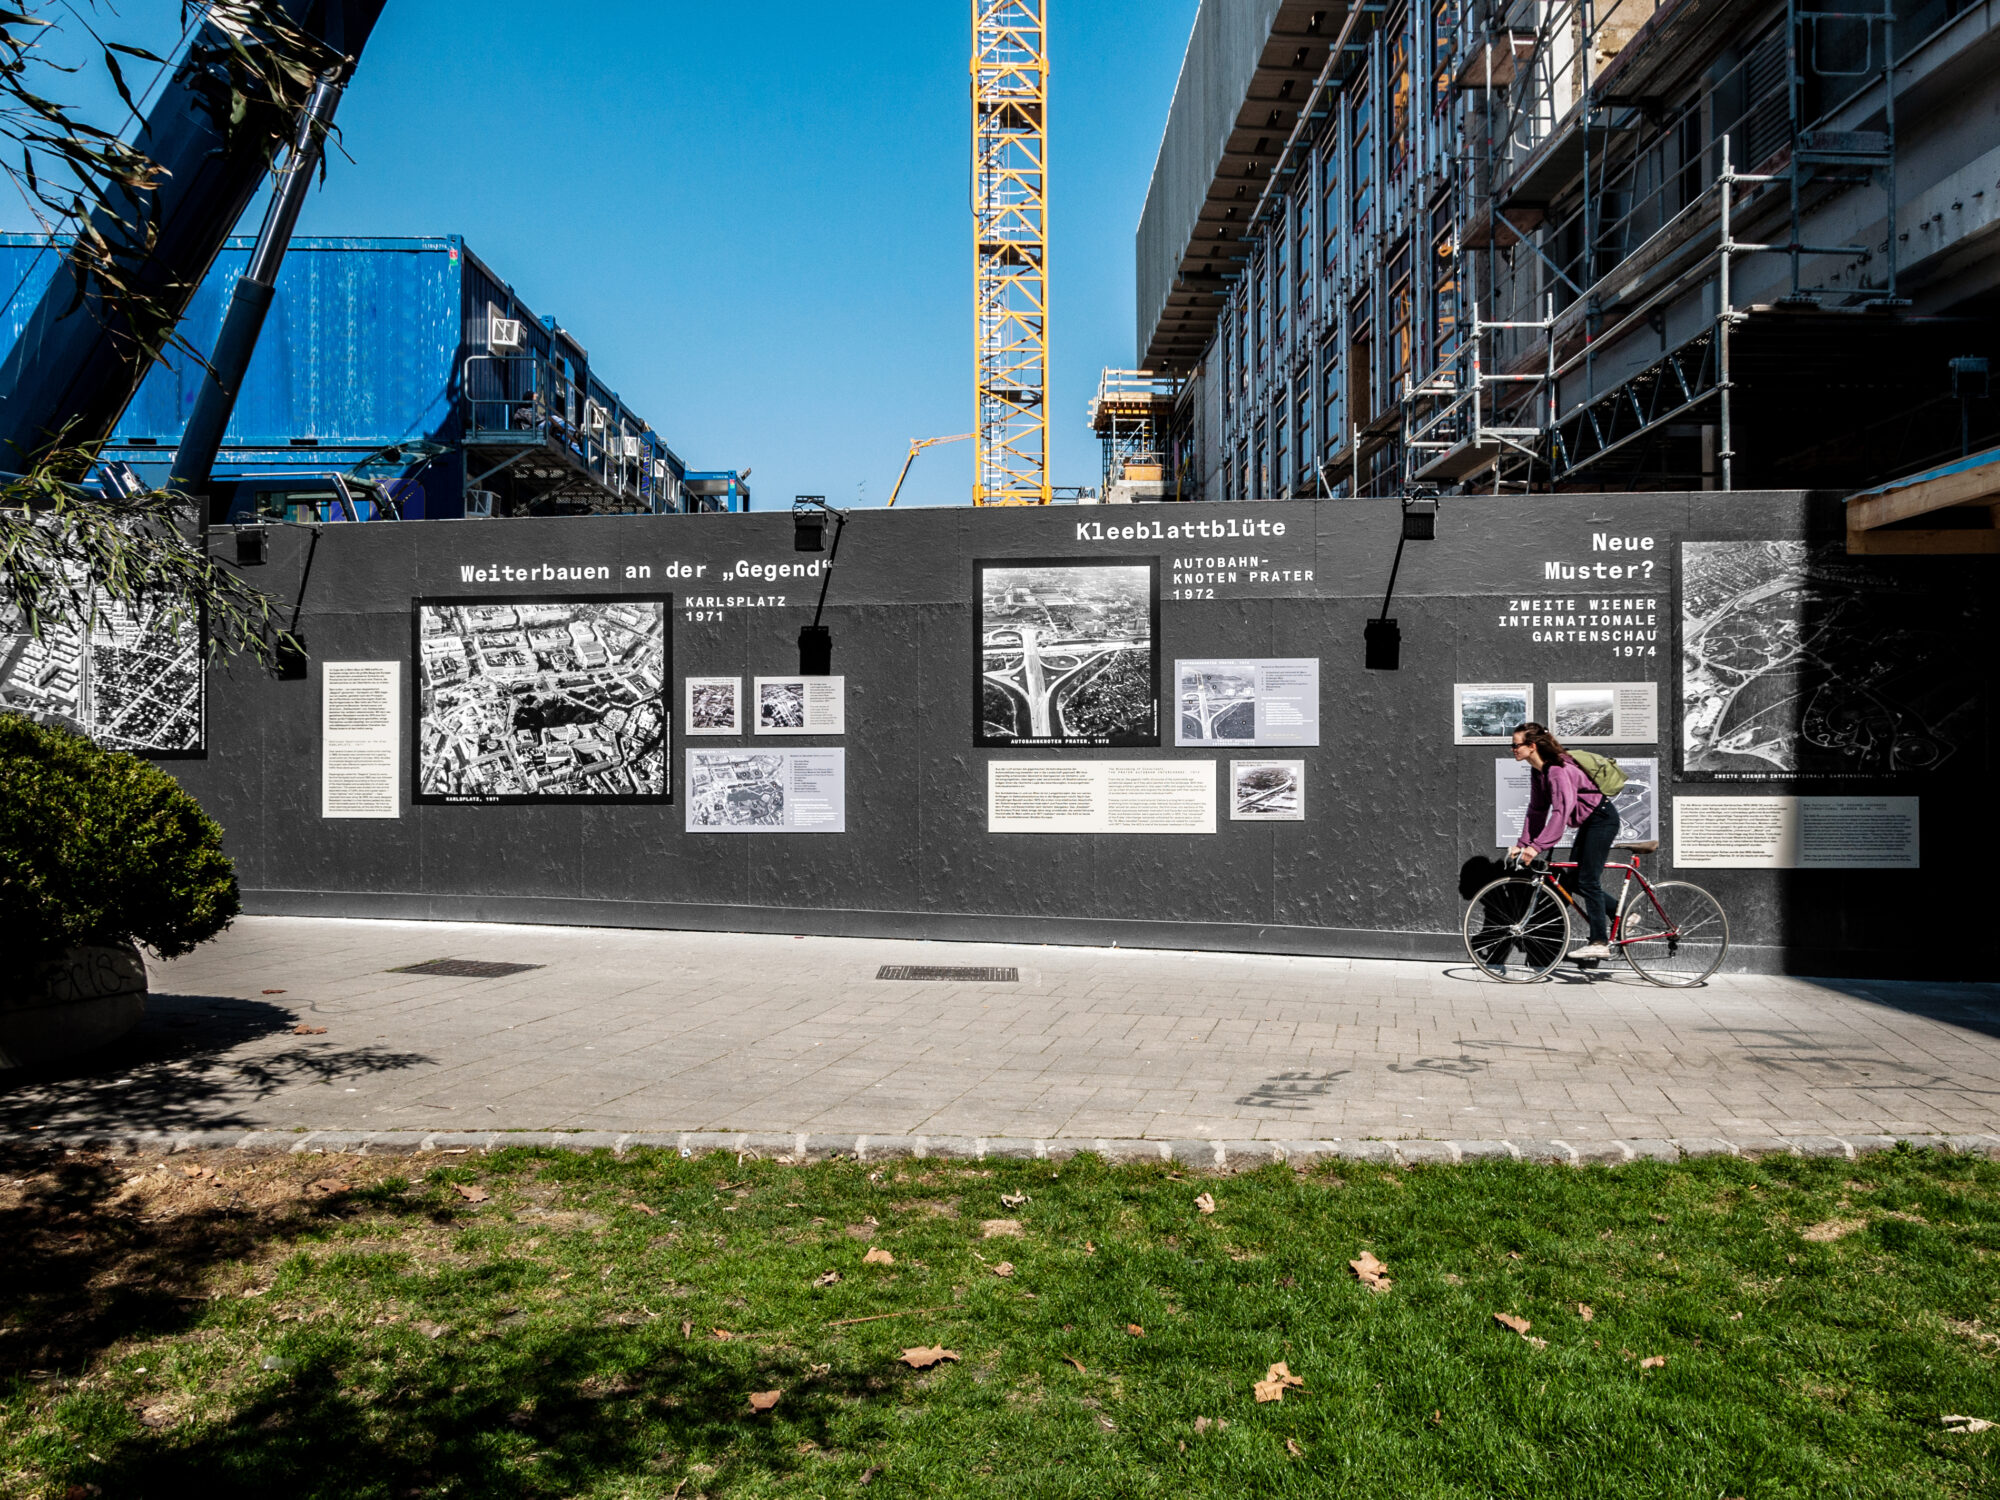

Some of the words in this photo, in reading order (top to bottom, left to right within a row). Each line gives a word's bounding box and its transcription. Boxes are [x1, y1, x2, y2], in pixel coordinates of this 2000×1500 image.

[1076, 518, 1286, 541] Kleeblattblüte
[1592, 532, 1655, 552] Neue
[1172, 555, 1269, 570] AUTOBAHN-
[1544, 559, 1654, 580] Muster?
[460, 563, 610, 583] Weiterbauen
[625, 565, 651, 579] an
[665, 560, 707, 579] der
[722, 559, 835, 582] „Gegend“
[1173, 571, 1237, 585] KNOTEN
[1249, 569, 1314, 583] PRATER
[685, 595, 786, 608] KARLSPLATZ
[1172, 588, 1215, 601] 1972
[1509, 599, 1576, 612] ZWEITE
[1588, 598, 1657, 611] WIENER
[685, 610, 723, 622] 1971
[1498, 614, 1656, 627] INTERNATIONALE
[1532, 629, 1658, 643] GARTENSCHAU
[1612, 645, 1657, 657] 1974
